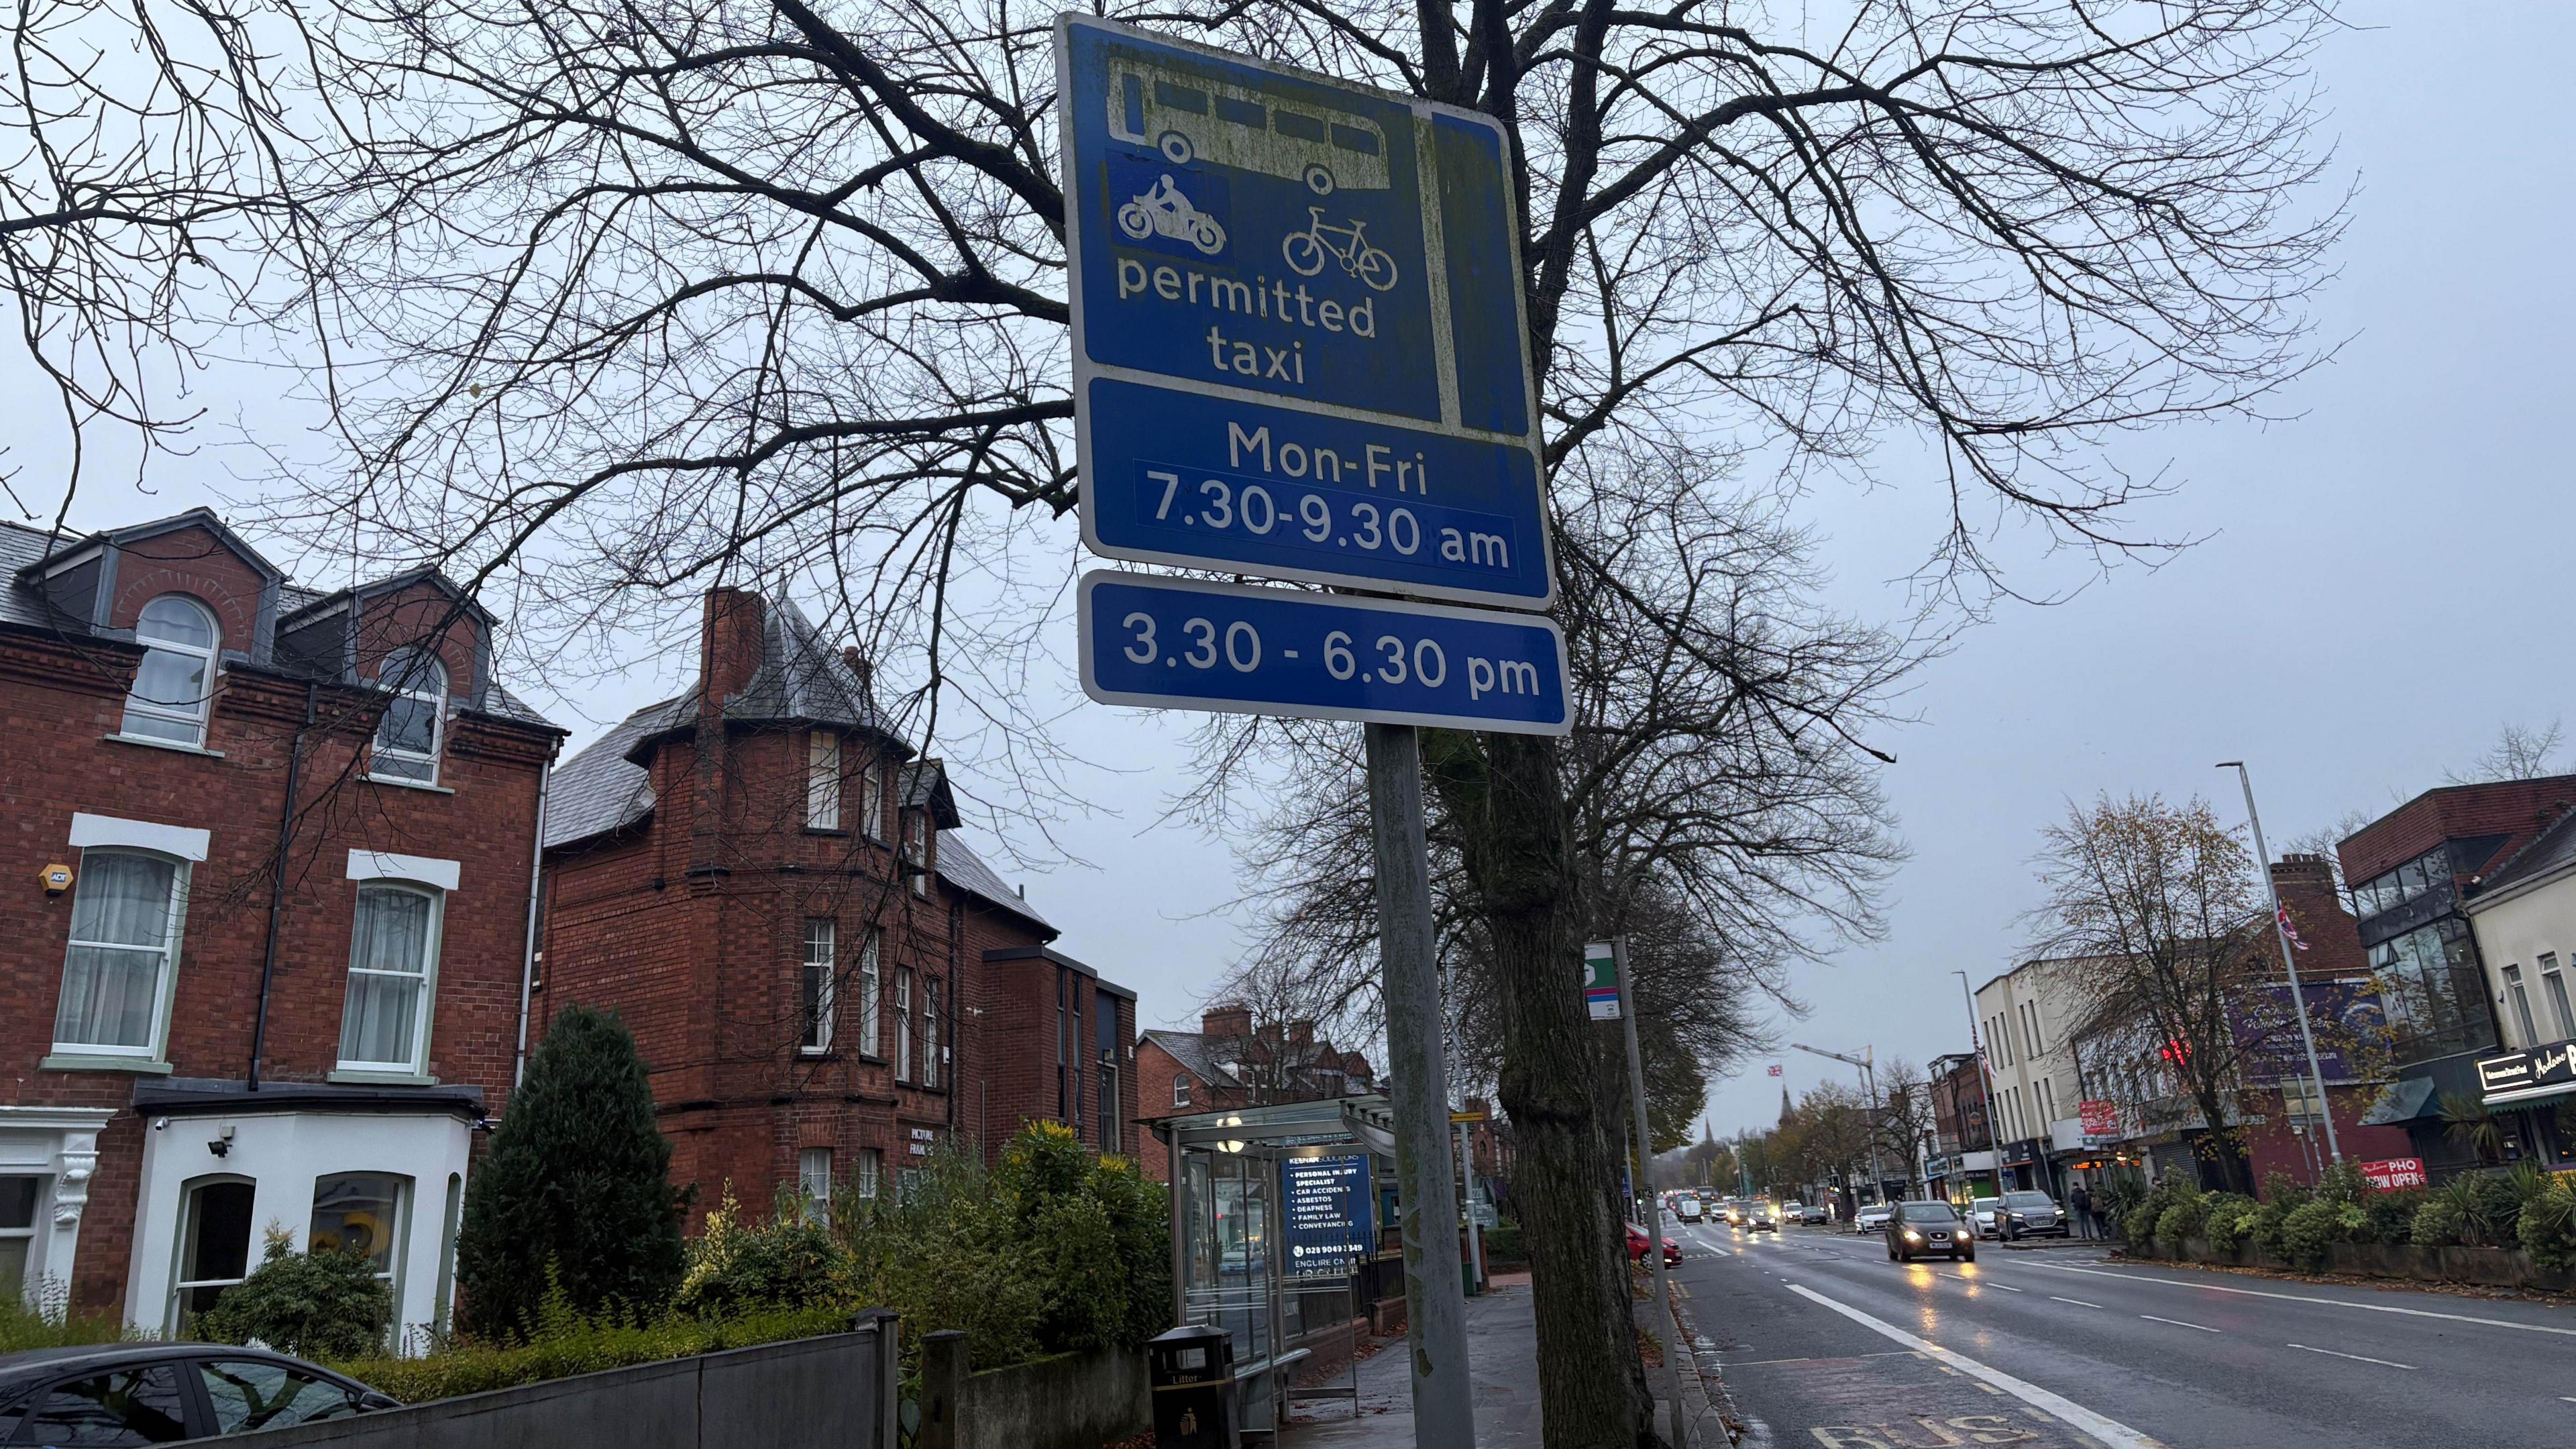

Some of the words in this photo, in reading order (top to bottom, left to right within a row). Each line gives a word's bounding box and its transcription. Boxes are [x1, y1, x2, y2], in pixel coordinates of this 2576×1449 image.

[1118, 257, 1376, 339] permitted
[1207, 325, 1305, 384] taxi
[1228, 421, 1427, 496] Mon-Fri
[1146, 470, 1420, 556] 7.30-9.30
[1440, 527, 1509, 569] am
[1122, 612, 1261, 674] 3.30
[1324, 630, 1446, 688] 6.30
[1467, 655, 1540, 701] pm
[911, 1128, 934, 1140] PICTURE
[2389, 1160, 2416, 1172] PHO
[1295, 1170, 1332, 1178] PERSONAL
[2392, 1172, 2420, 1187] OPEN
[1295, 1179, 1335, 1187] SPECIALIST
[1312, 1186, 1351, 1194] ACCIDENS
[1297, 1196, 1332, 1204] ASBESTOS
[1297, 1204, 1333, 1213] DEAFNESS
[1173, 1375, 1198, 1385] Litter
